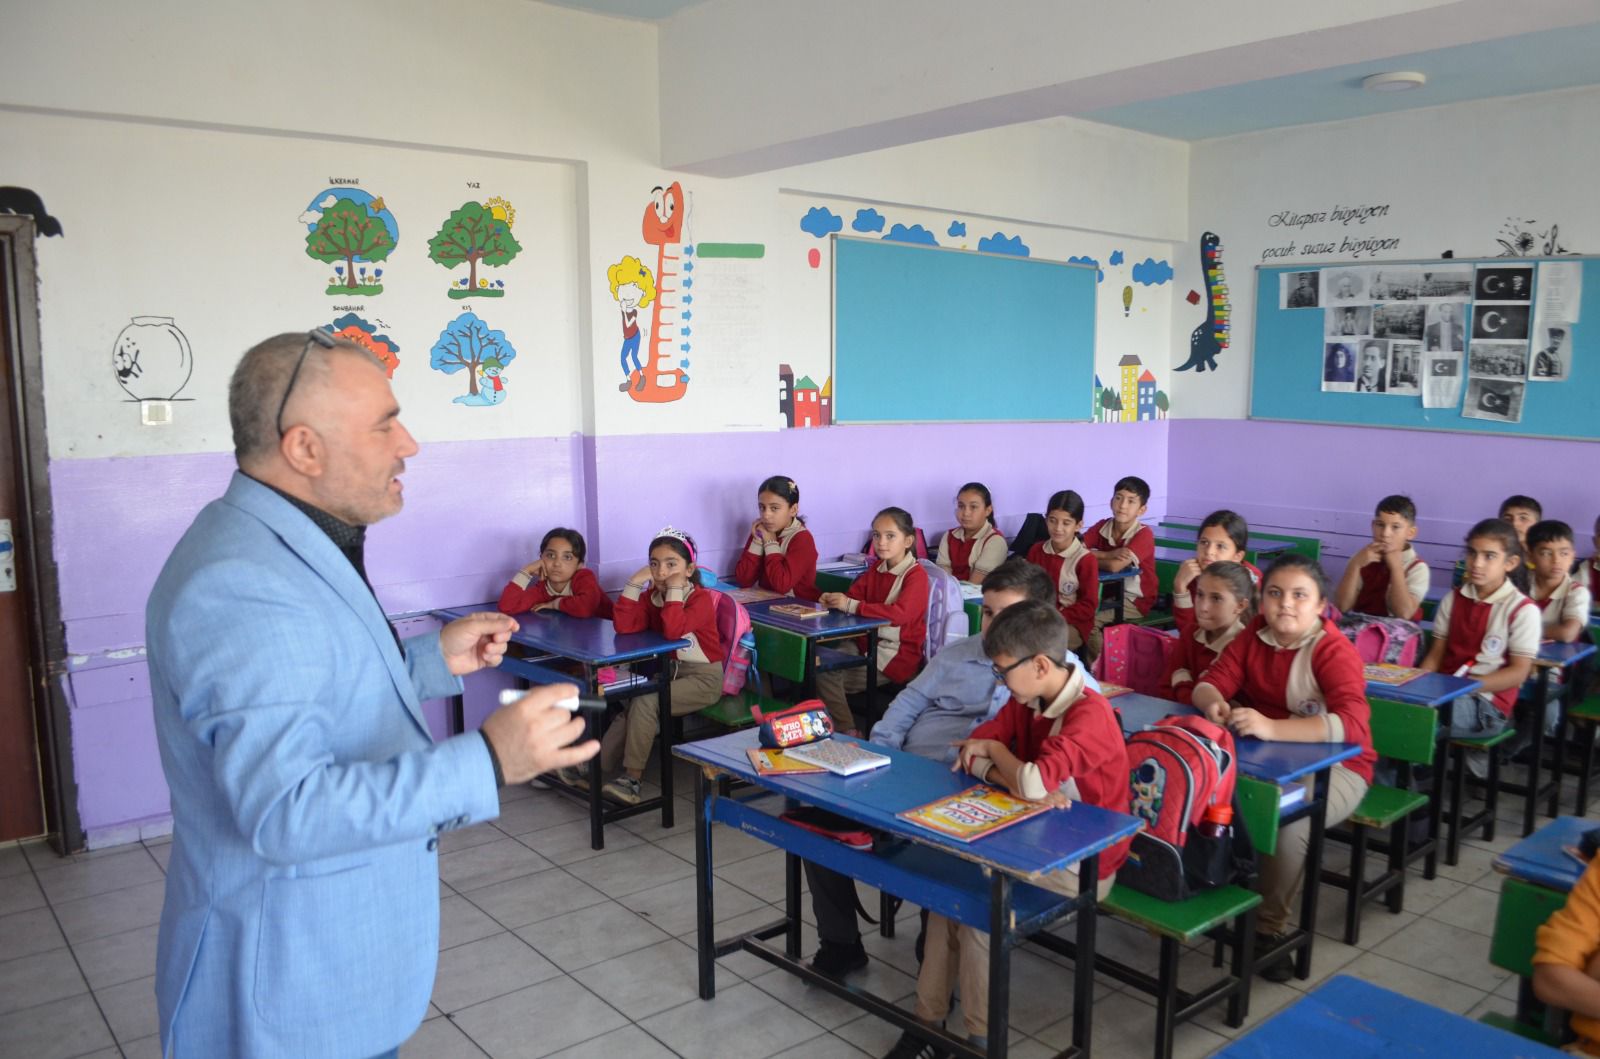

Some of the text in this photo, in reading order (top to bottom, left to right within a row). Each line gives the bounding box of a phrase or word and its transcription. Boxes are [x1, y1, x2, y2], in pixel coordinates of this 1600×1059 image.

[1300, 242, 1337, 256] susuz
[781, 721, 801, 732] WHO
[783, 729, 803, 741] ME?
